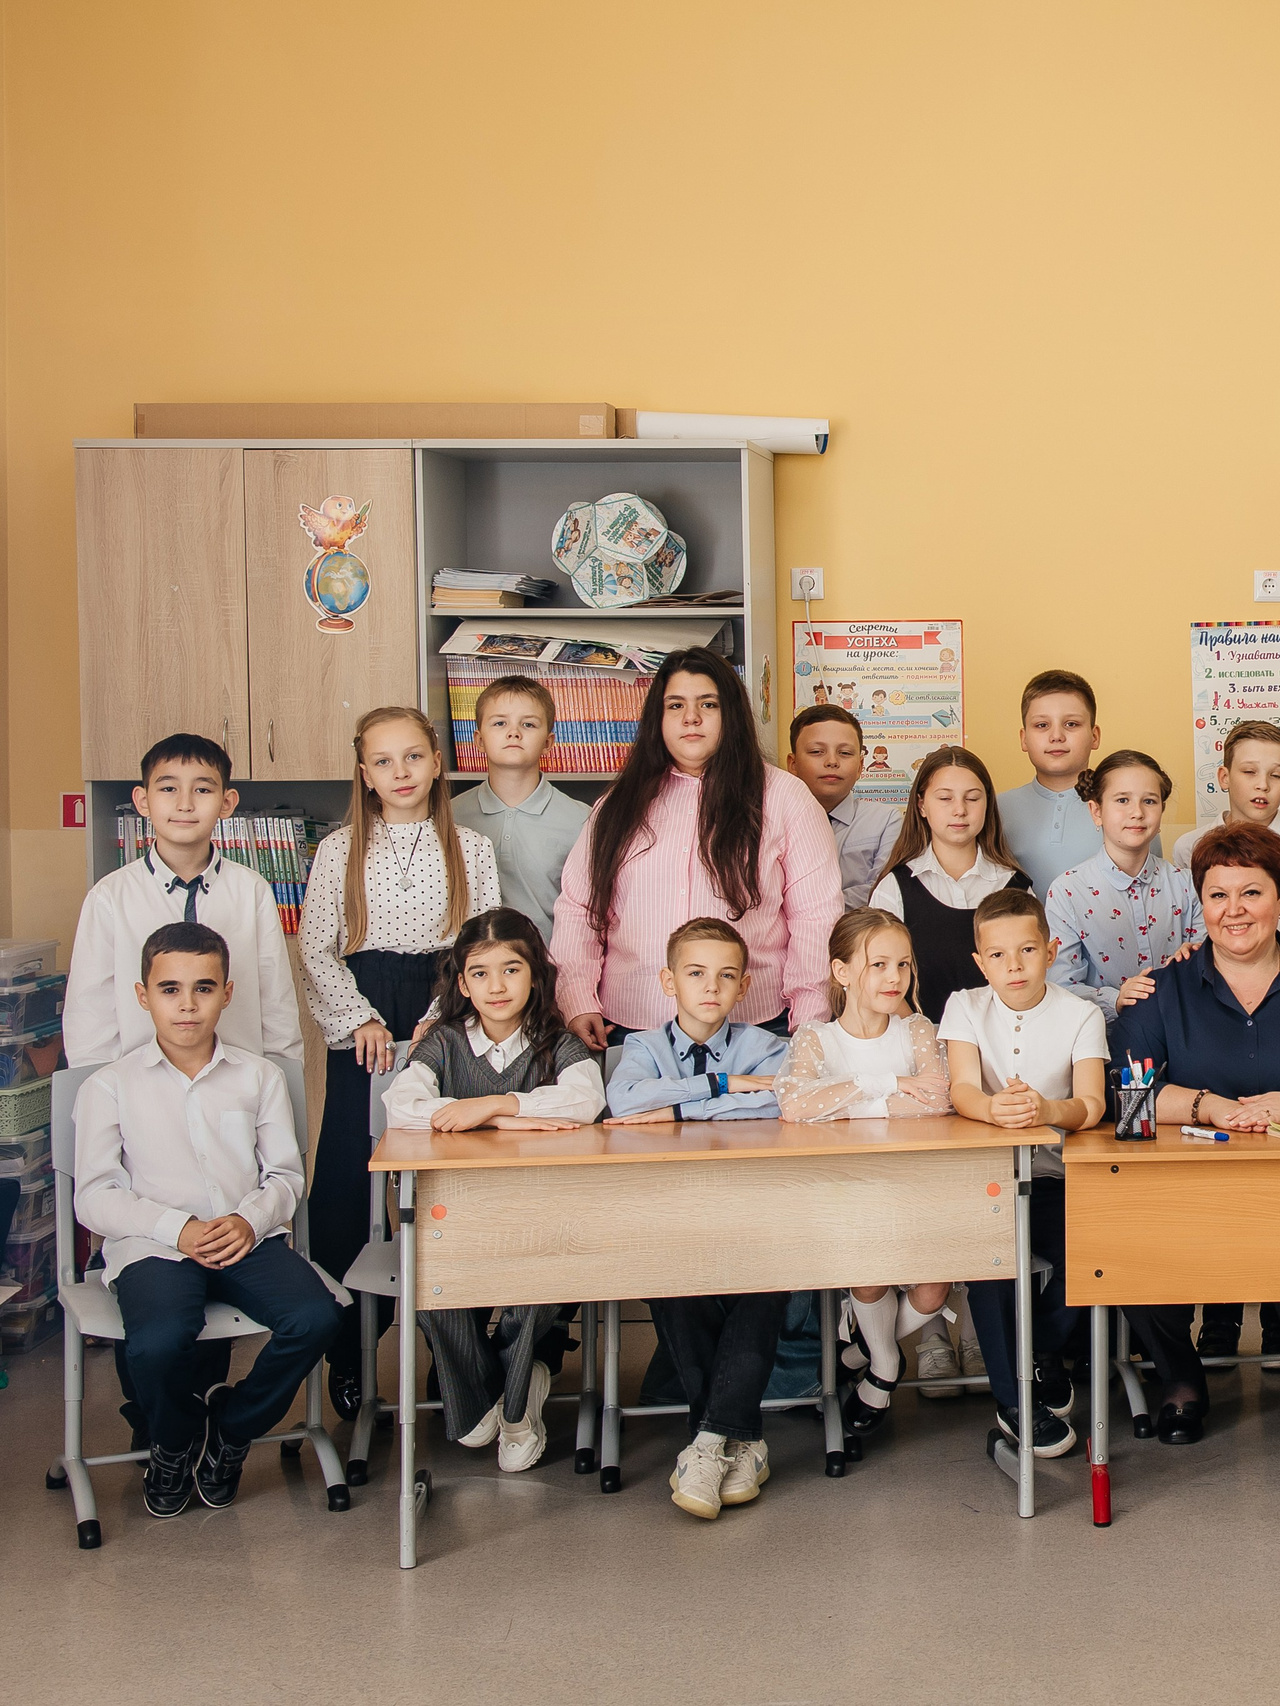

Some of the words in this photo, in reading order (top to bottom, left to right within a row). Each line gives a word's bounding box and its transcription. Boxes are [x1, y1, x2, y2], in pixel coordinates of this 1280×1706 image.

[848, 624, 899, 634] Секреты
[846, 637, 898, 648] УСПЕХА
[1199, 629, 1257, 651] Правила
[862, 650, 899, 662] уроке:
[1214, 650, 1225, 661] 1.
[1227, 650, 1280, 663] Узнавать
[822, 664, 866, 674] выкрикивай
[1204, 667, 1216, 679] 2.
[1218, 670, 1275, 678] ИССЛЕДОВАТЬ
[1228, 683, 1240, 693] 3.
[1242, 685, 1265, 693] БЫТЬ
[1223, 699, 1235, 710] 4.
[1237, 698, 1279, 709] Уважать
[1209, 715, 1221, 726] 5.
[1206, 782, 1218, 793] 8.
